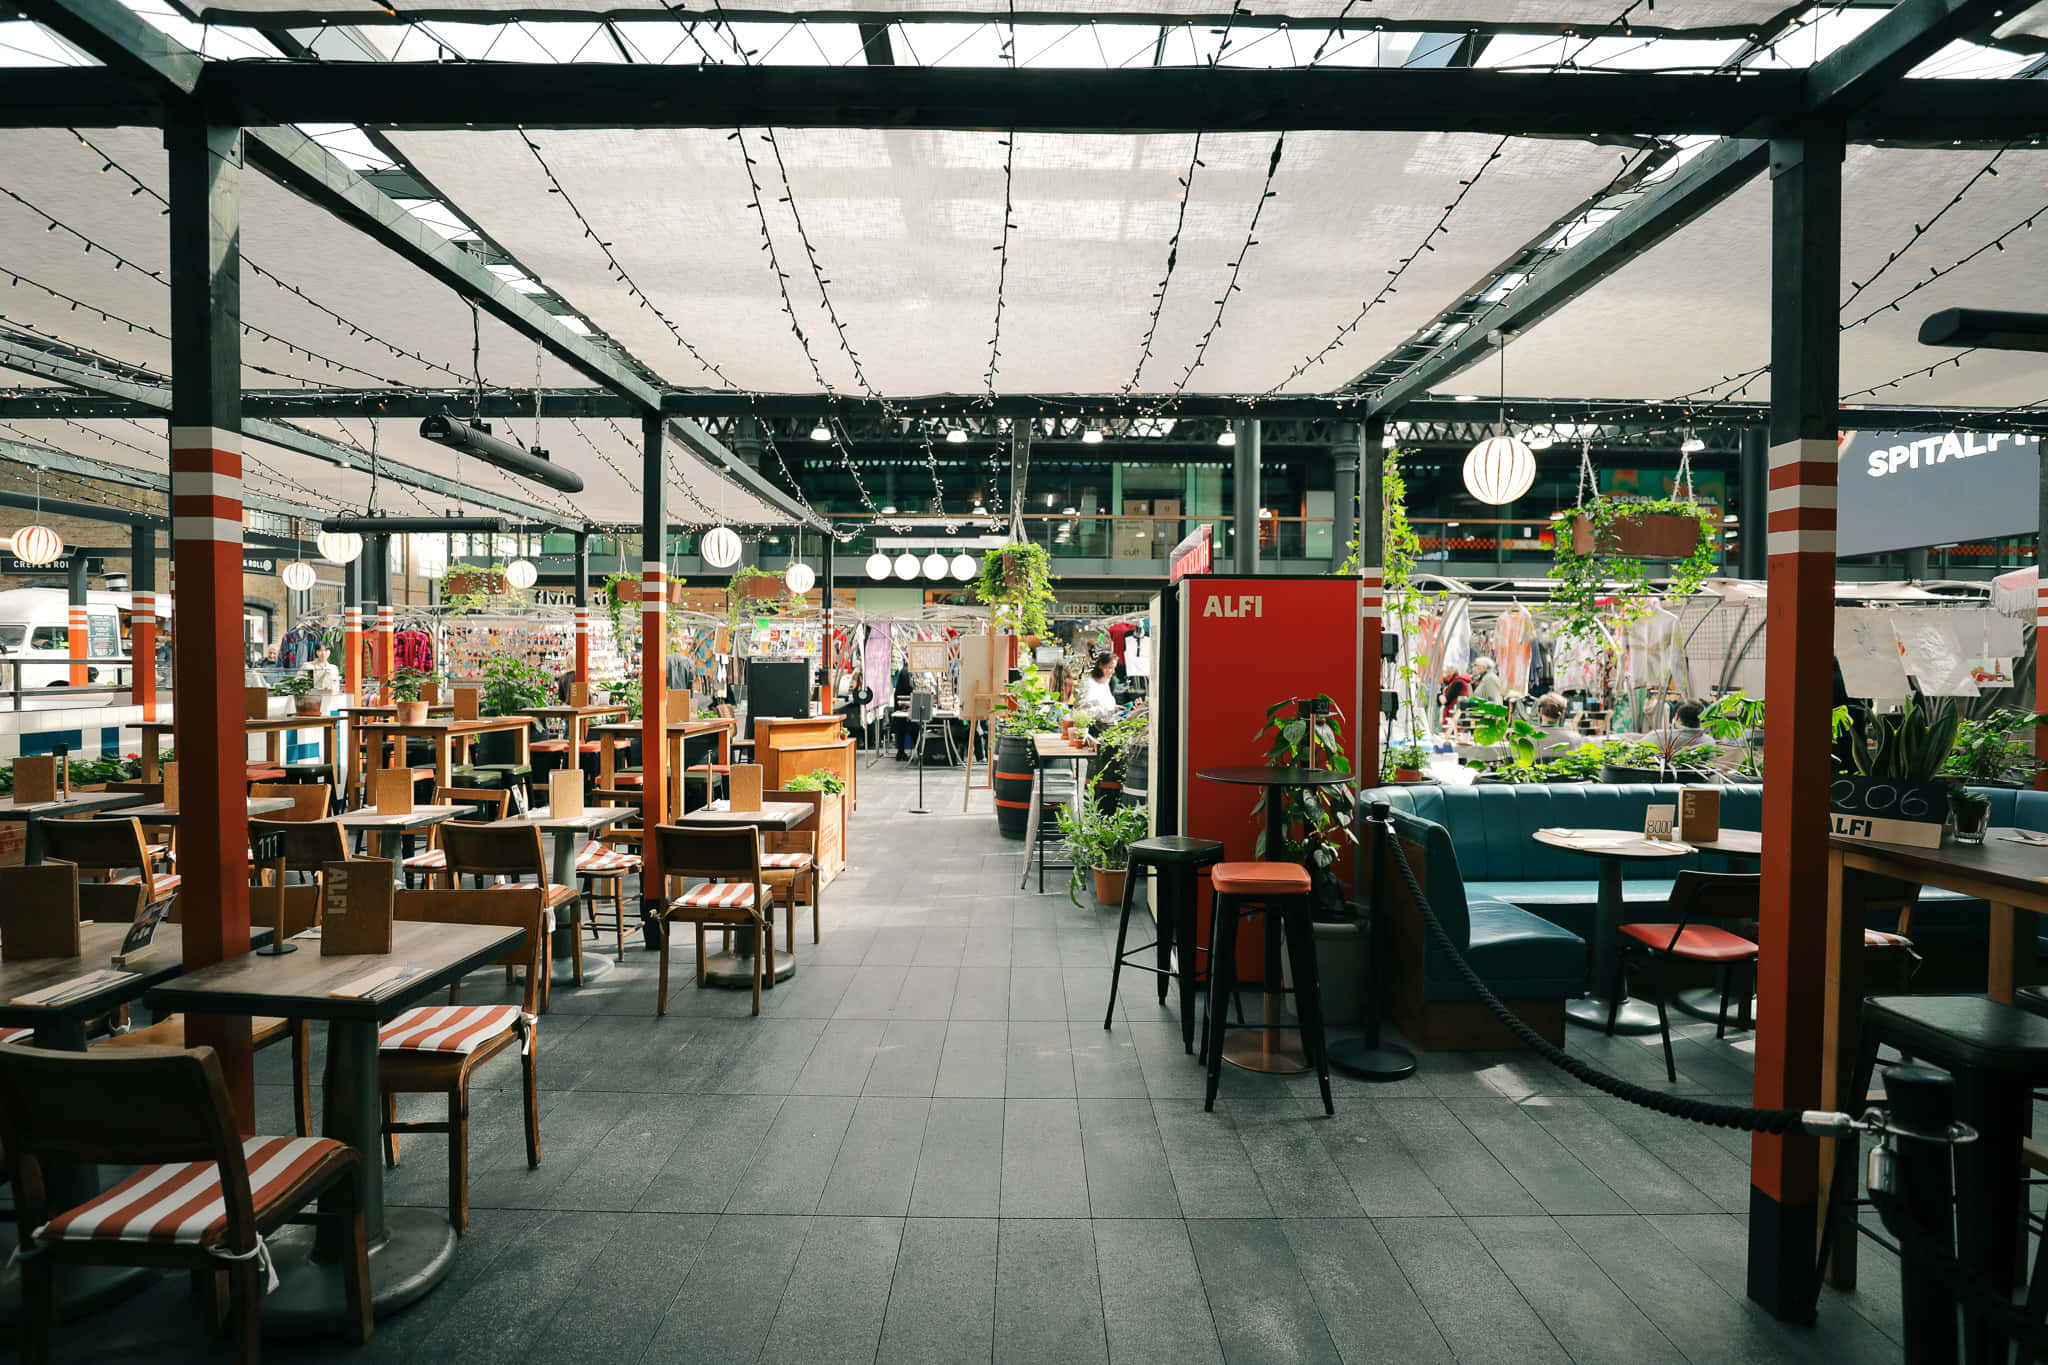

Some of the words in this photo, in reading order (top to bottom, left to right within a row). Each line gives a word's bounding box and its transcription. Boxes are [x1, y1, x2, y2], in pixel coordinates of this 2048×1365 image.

[1867, 432, 2040, 477] SPITALF
[1063, 603, 1104, 615] GREEK
[1203, 595, 1262, 617] ALFI
[1684, 792, 1697, 819] ALFI
[1831, 780, 1929, 816] 206
[327, 867, 348, 914] ALFI
